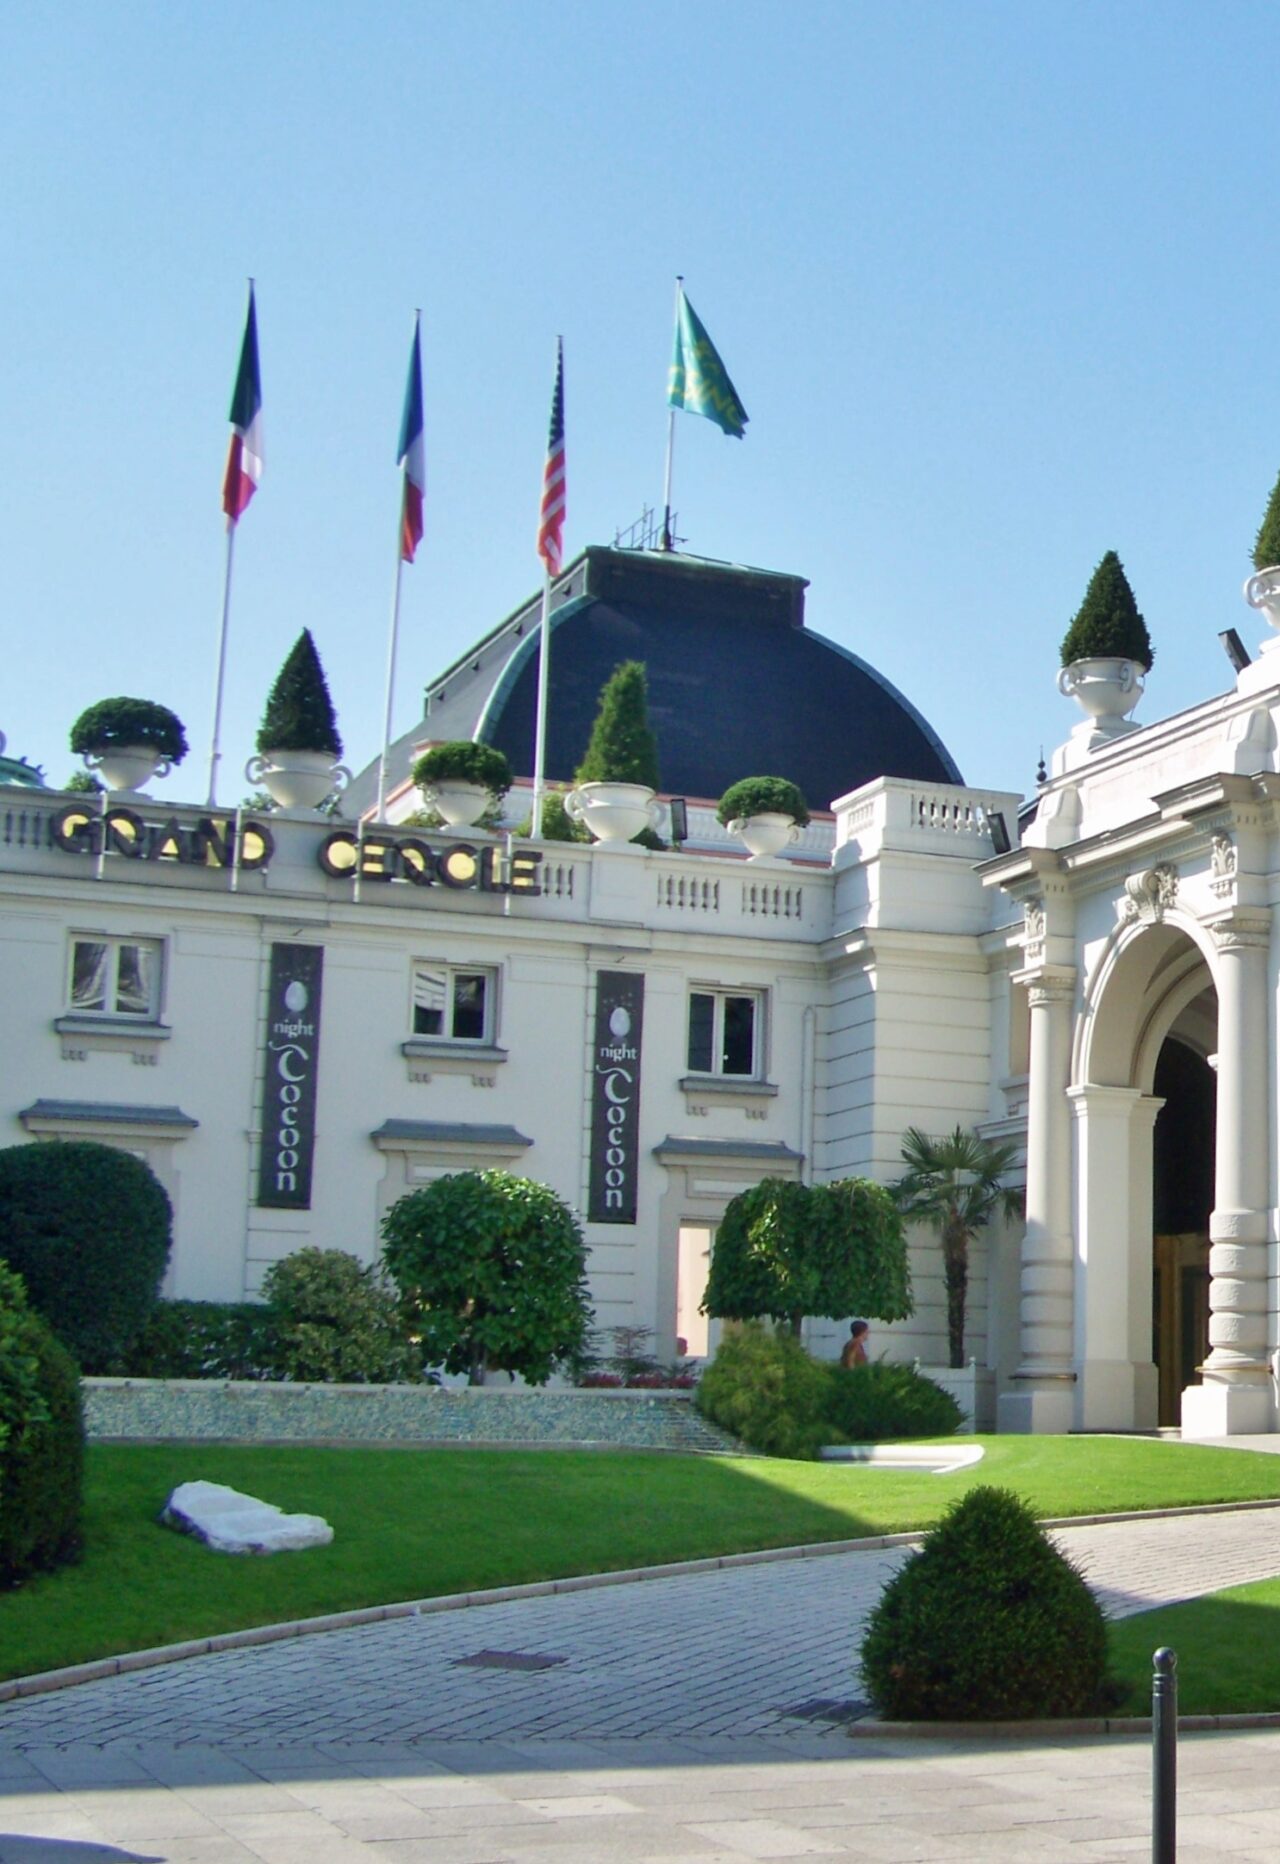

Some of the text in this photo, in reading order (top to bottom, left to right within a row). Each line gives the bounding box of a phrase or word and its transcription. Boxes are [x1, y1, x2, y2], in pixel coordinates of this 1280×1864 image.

[52, 804, 542, 896] GRAND CERCLE
[273, 1018, 314, 1038] night
[600, 1043, 637, 1062] night
[268, 1041, 309, 1191] Cocoon
[596, 1064, 632, 1208] Cocoon
